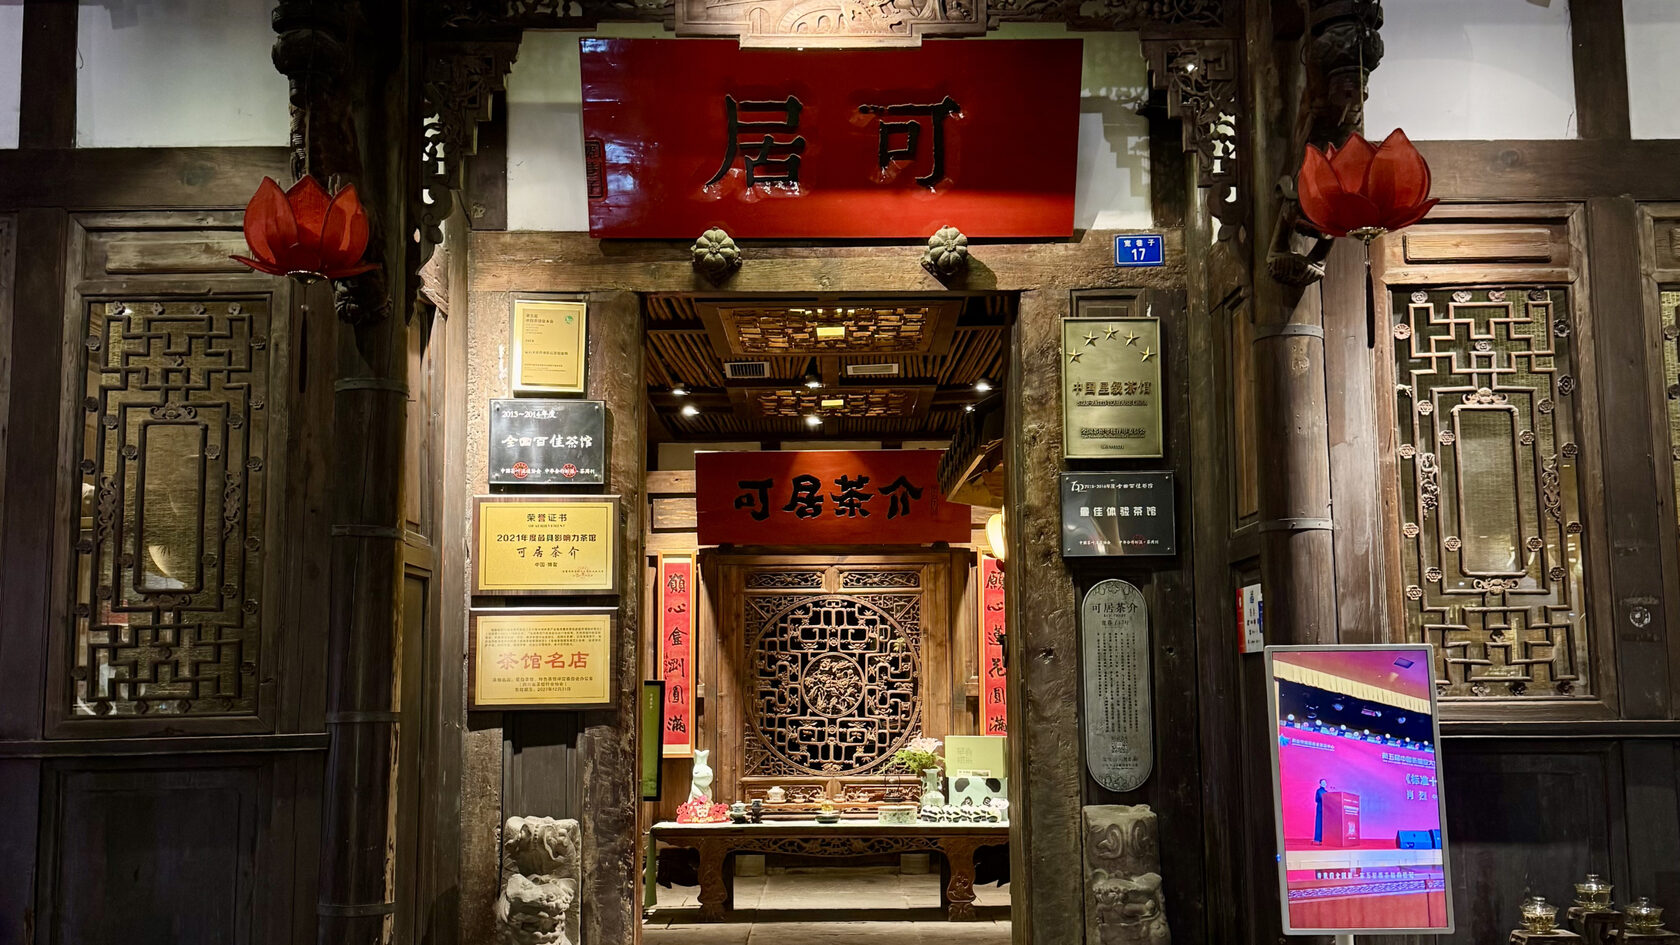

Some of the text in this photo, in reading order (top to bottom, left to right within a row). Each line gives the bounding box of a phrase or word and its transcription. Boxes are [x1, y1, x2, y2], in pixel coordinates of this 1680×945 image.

[1131, 248, 1146, 261] 17
[1072, 381, 1152, 396] 中国星级茶馆
[501, 434, 593, 449] 全国百佳茶馆
[734, 474, 924, 521] 可居茶介
[527, 513, 568, 522] 荣誉证书
[1079, 506, 1157, 517] 最佳体验茶馆
[497, 533, 597, 542] 2021年度最具影响力茶馆
[516, 545, 580, 560] 可居茶介
[1092, 602, 1138, 614] 可居茶介
[496, 651, 590, 670] 茶馆名店
